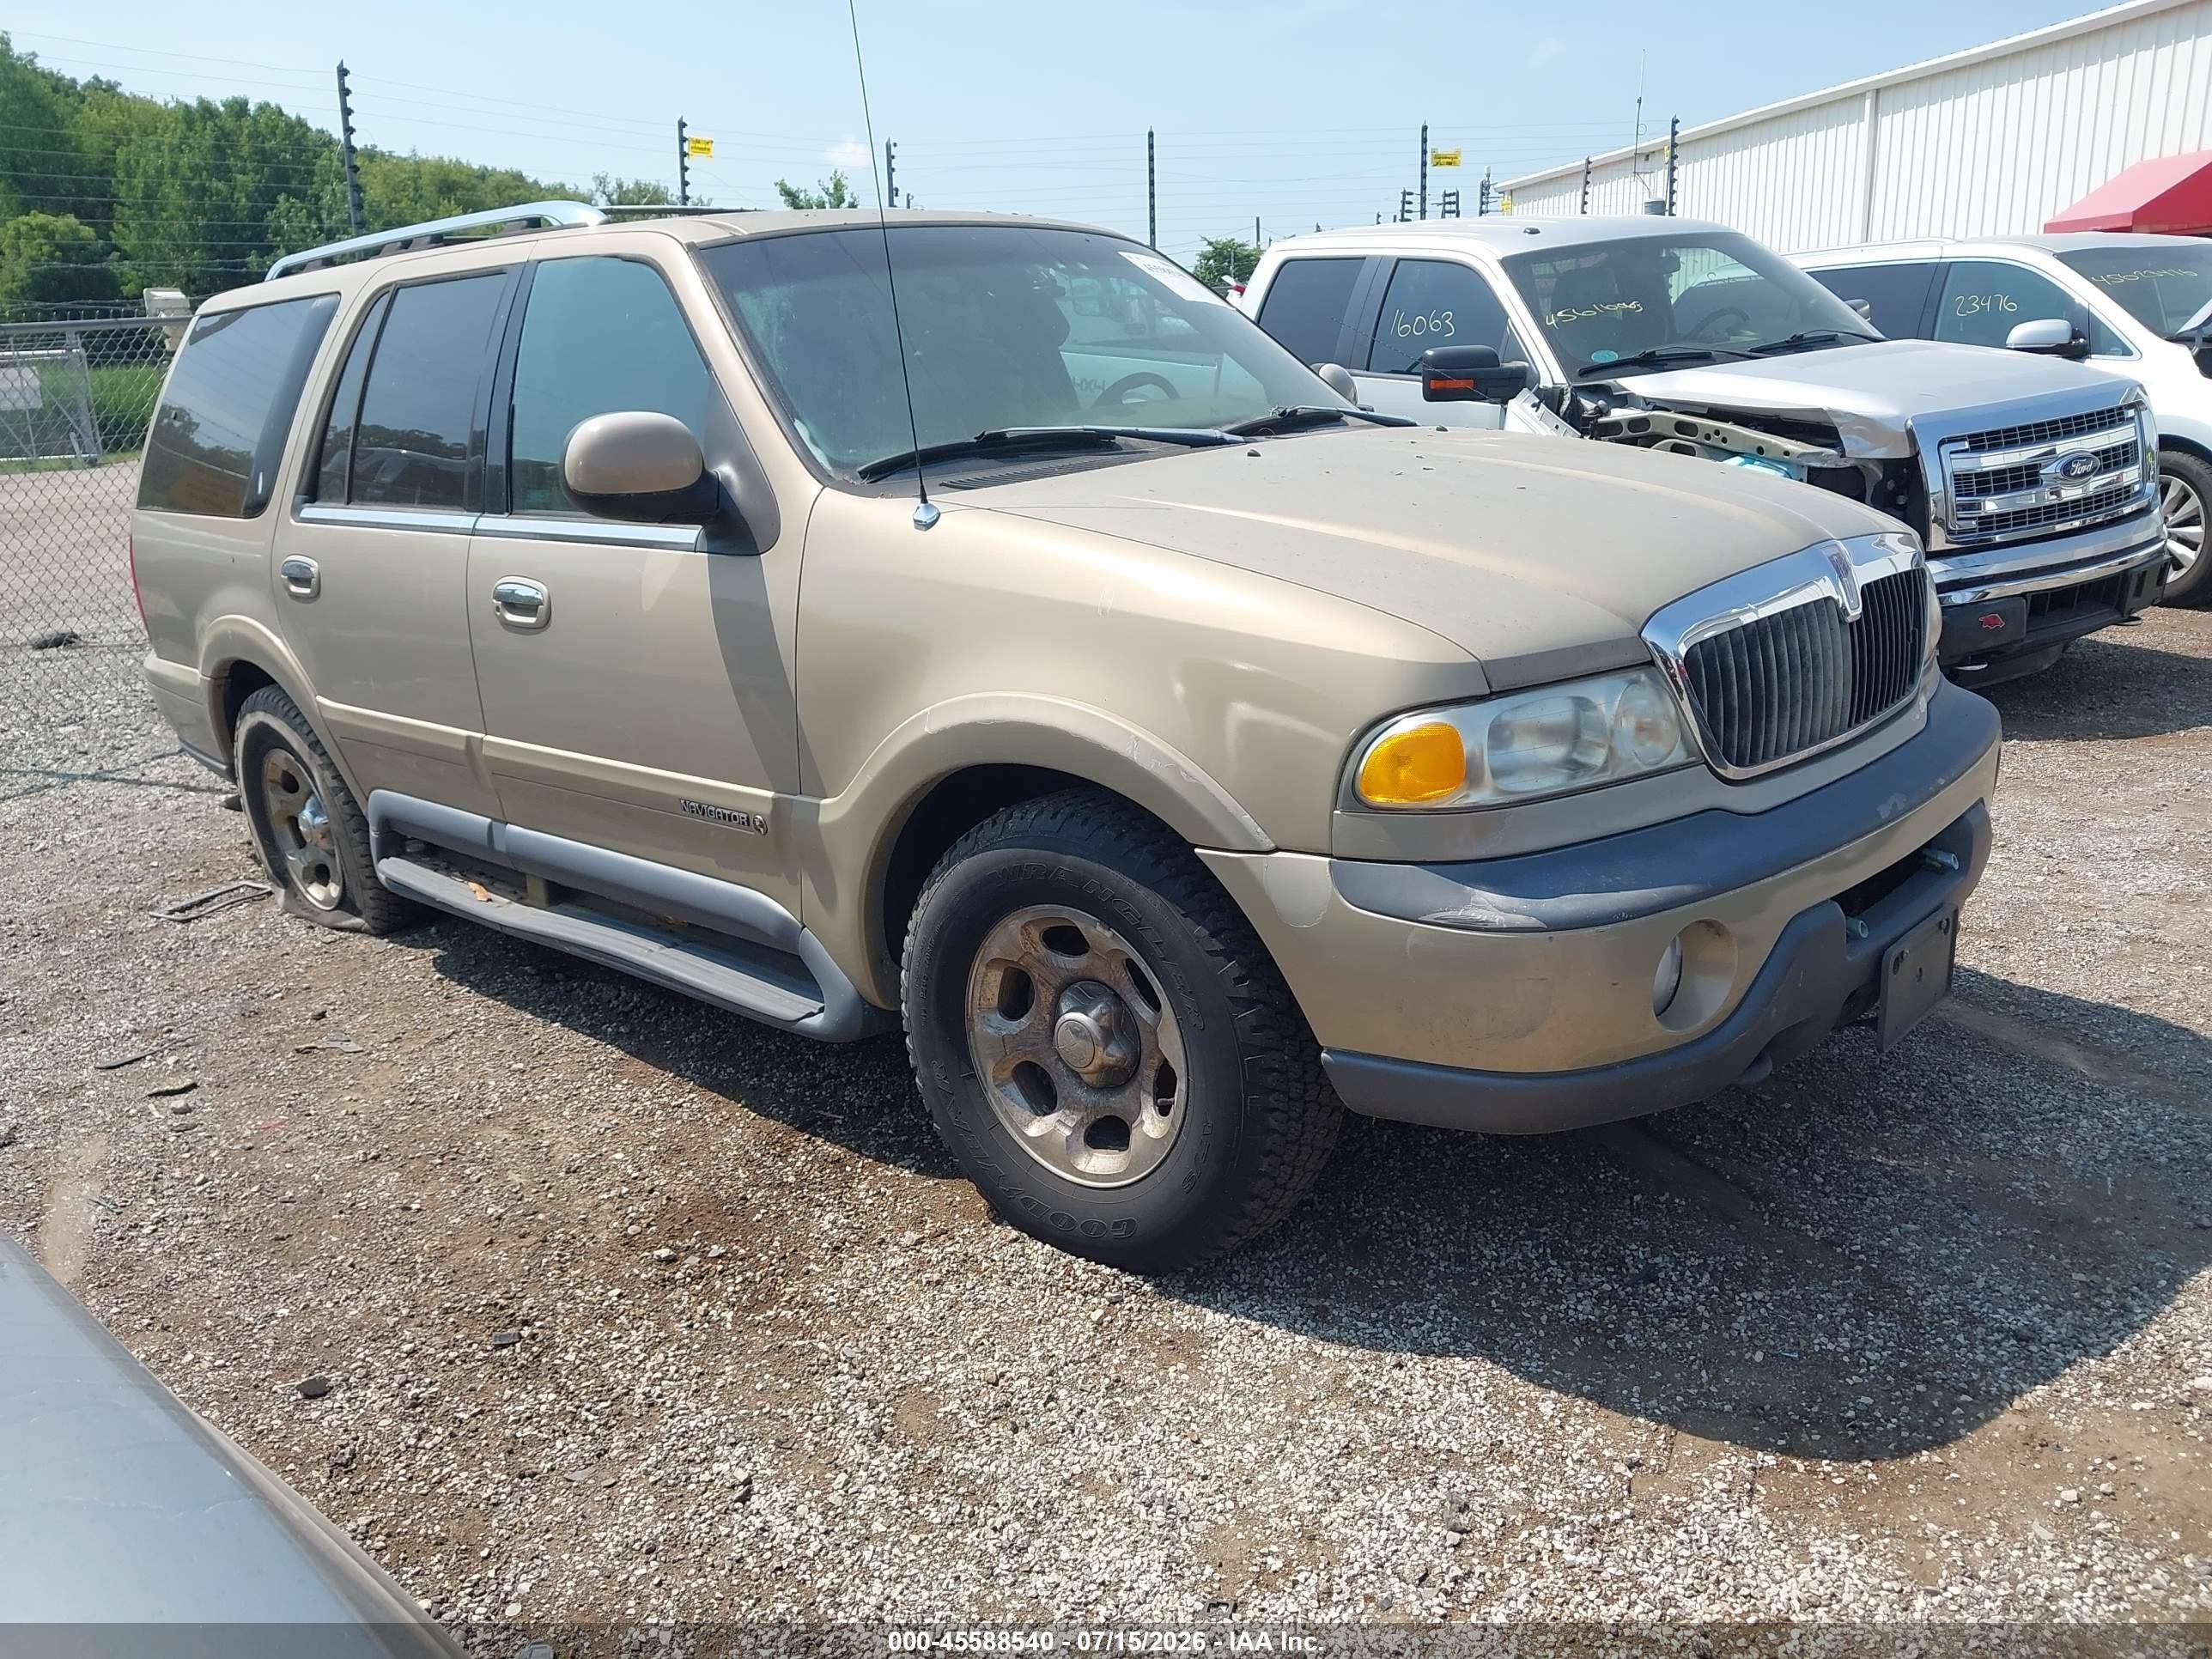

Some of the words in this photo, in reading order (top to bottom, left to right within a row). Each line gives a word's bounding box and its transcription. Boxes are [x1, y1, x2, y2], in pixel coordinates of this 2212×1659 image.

[1954, 294, 2018, 318] 23476
[1389, 308, 1457, 338] 16063
[2069, 458, 2094, 477] Ford
[679, 798, 750, 827] NAVIGATOR
[987, 860, 1205, 1031] WRANGLER
[928, 1058, 1139, 1240] GOODYEAR
